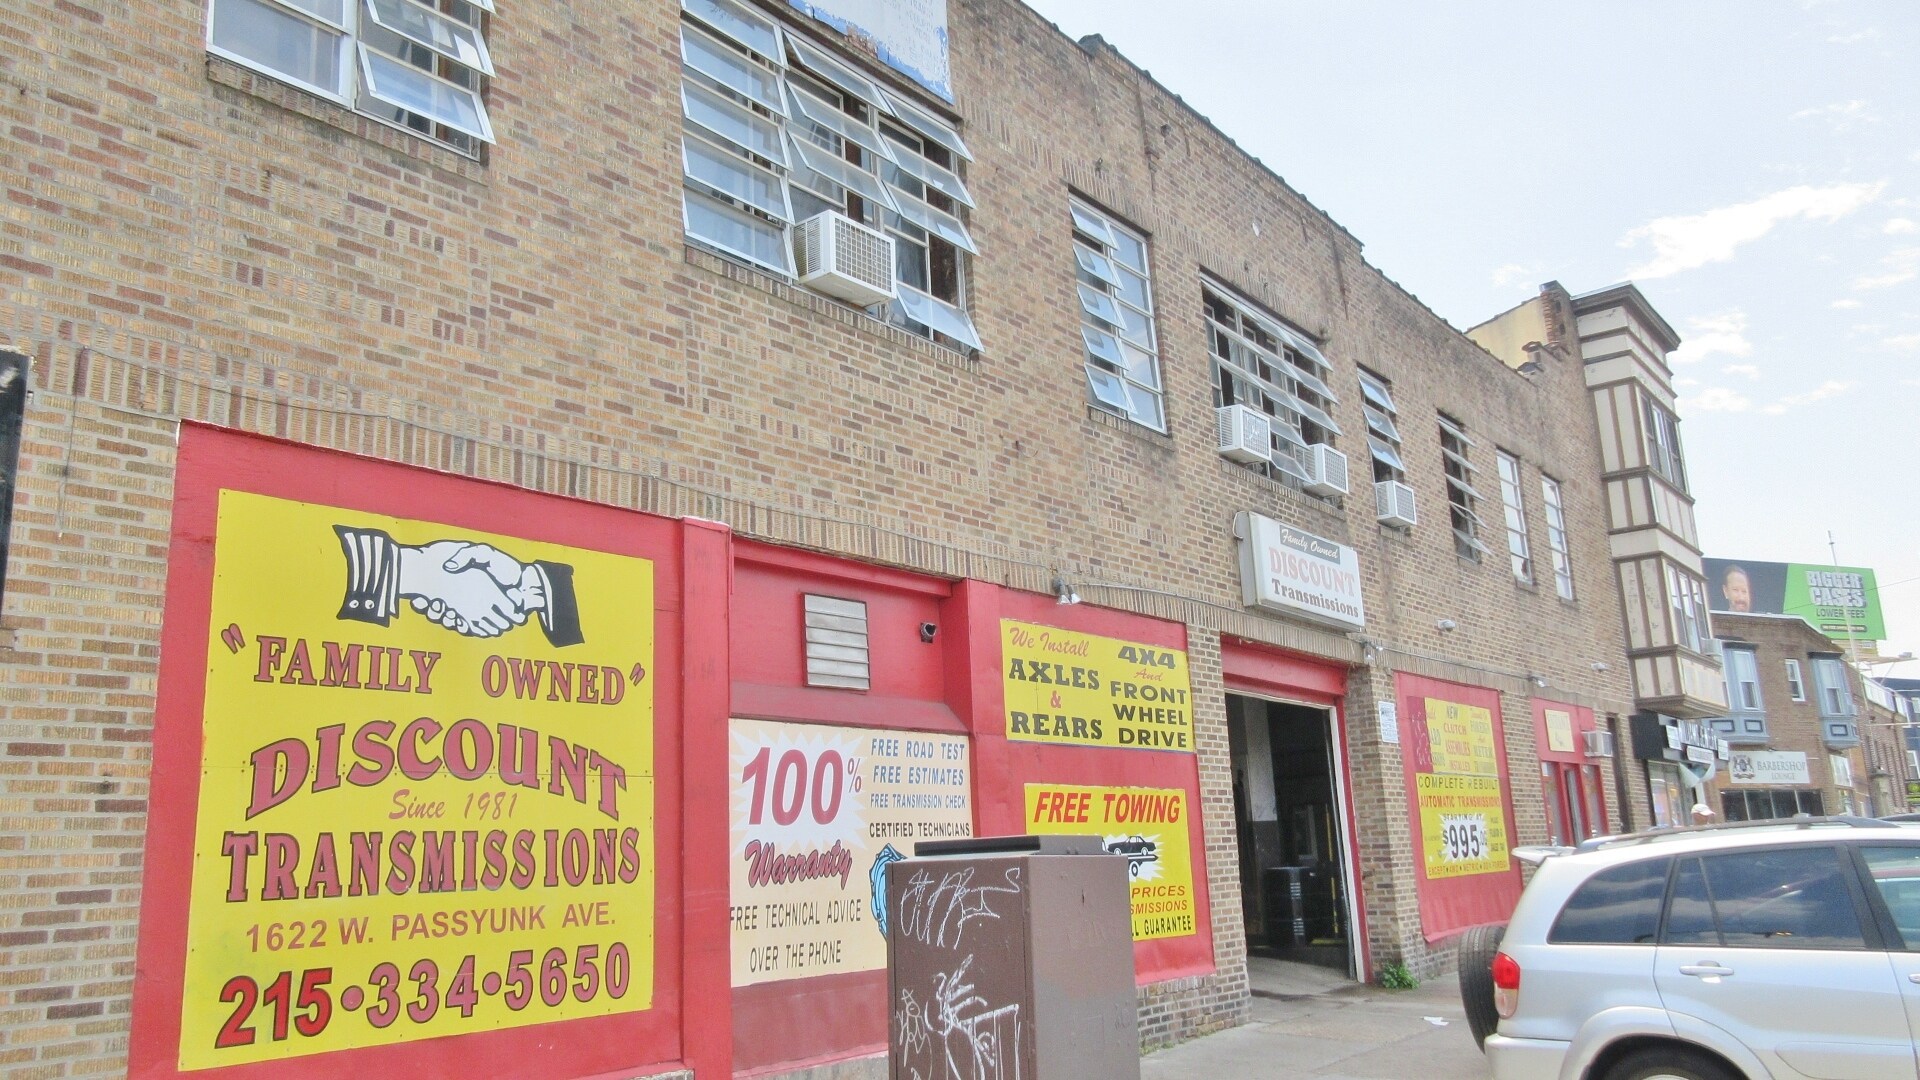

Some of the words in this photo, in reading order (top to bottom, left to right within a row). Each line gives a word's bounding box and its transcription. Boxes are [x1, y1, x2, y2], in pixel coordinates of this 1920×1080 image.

[1310, 540, 1339, 560] Owned
[1268, 546, 1355, 597] DISCOUNT
[1806, 571, 1863, 589] BIGGER
[1271, 577, 1359, 618] Transmissions
[1809, 586, 1866, 608] CASES
[1816, 608, 1844, 618] LOWER
[1009, 627, 1035, 648] We
[1039, 631, 1090, 658] Install
[1008, 657, 1100, 691] AXLES
[1133, 667, 1163, 682] And
[1050, 690, 1062, 709] &
[1110, 680, 1187, 705] FRONT
[1010, 711, 1103, 740] REARS
[1112, 703, 1188, 726] WHEEL
[1118, 727, 1187, 748] DRIVE
[871, 738, 899, 758] FREE
[906, 740, 934, 759] ROAD
[941, 742, 965, 761] TEST
[245, 716, 628, 821] DISCOUNT
[873, 765, 901, 784] FREE
[908, 766, 964, 786] ESTIMATES
[1757, 760, 1806, 771] BARBERSHOP
[741, 746, 862, 826] 100%
[1418, 776, 1464, 789] COMPLETE
[1467, 778, 1498, 790] REBUILT
[388, 789, 446, 820] Since
[463, 792, 519, 820] 1981
[870, 793, 889, 808] FREE
[892, 793, 943, 809] TRANSMISSION
[945, 794, 966, 809] CHECK
[1033, 791, 1092, 823] FREE
[1103, 793, 1181, 824] TOWING
[1419, 795, 1455, 808] AUTOMATIC
[869, 822, 914, 838] CERTIFIED
[918, 822, 970, 837] TECHNICIANS
[221, 826, 641, 903] TRANSMISSIONS
[744, 839, 853, 890] Warranty
[1131, 885, 1186, 899] PRICES
[730, 905, 758, 931] FREE
[764, 901, 820, 928] TECHNICAL
[826, 898, 862, 924] ADVICE
[1131, 900, 1188, 915] SMISSIONS
[245, 919, 327, 953] 1622
[338, 916, 374, 945] W.
[391, 904, 546, 941] PASSYUNK
[561, 901, 616, 929] AVE.
[1144, 915, 1192, 936] GUARANTEE
[750, 946, 779, 973] OVER
[785, 943, 805, 967] THE
[808, 940, 842, 966] PHONE
